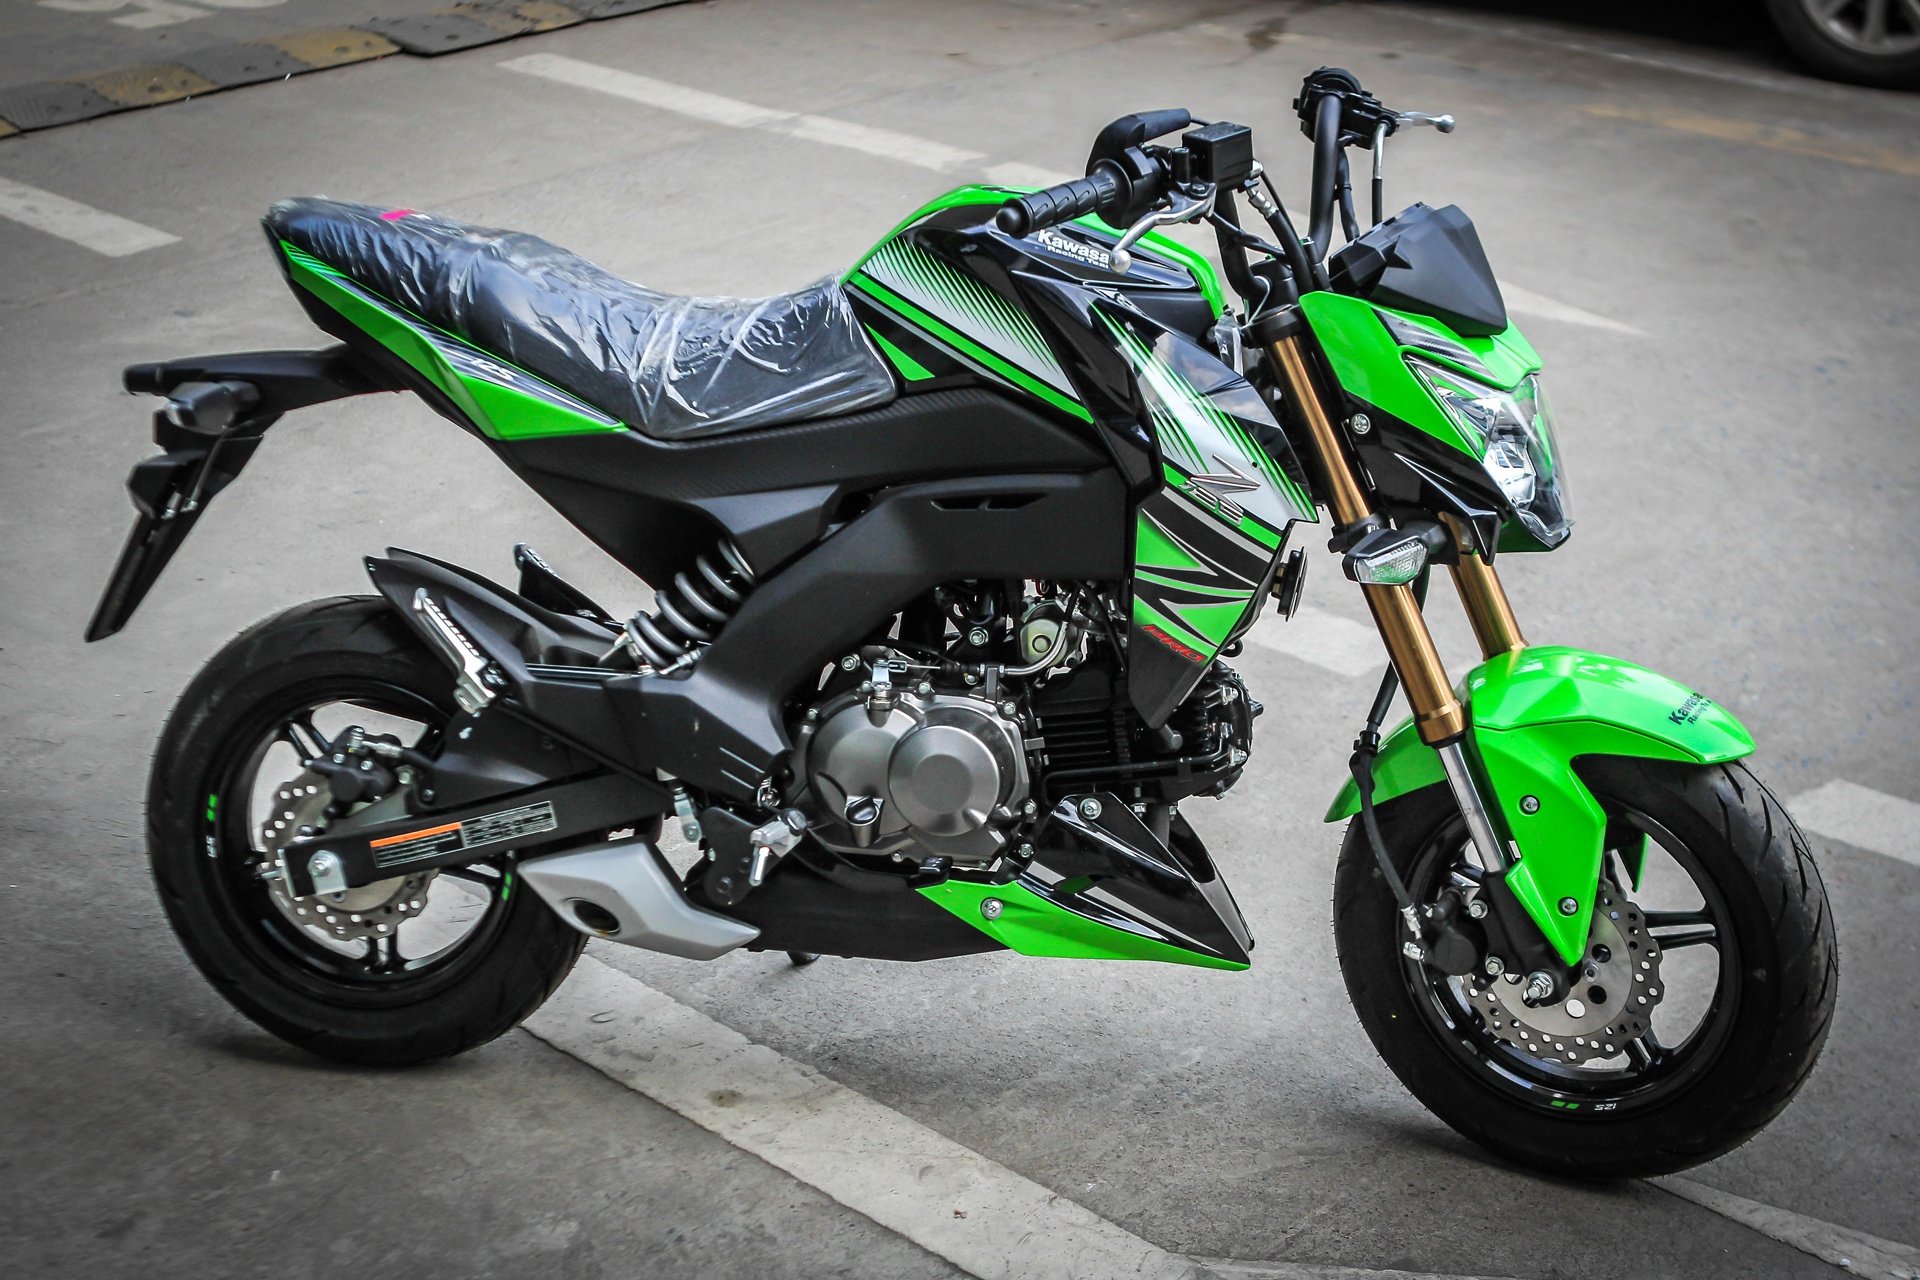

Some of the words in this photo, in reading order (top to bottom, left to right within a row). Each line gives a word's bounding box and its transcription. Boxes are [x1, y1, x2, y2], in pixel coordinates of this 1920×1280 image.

[1038, 229, 1110, 264] Kawasa
[1048, 246, 1085, 262] Racing
[1178, 480, 1244, 526] 125
[1141, 624, 1208, 662] PRO
[1668, 692, 1704, 726] Kawasa
[1687, 704, 1708, 725] Racing
[1594, 1103, 1617, 1111] 125
